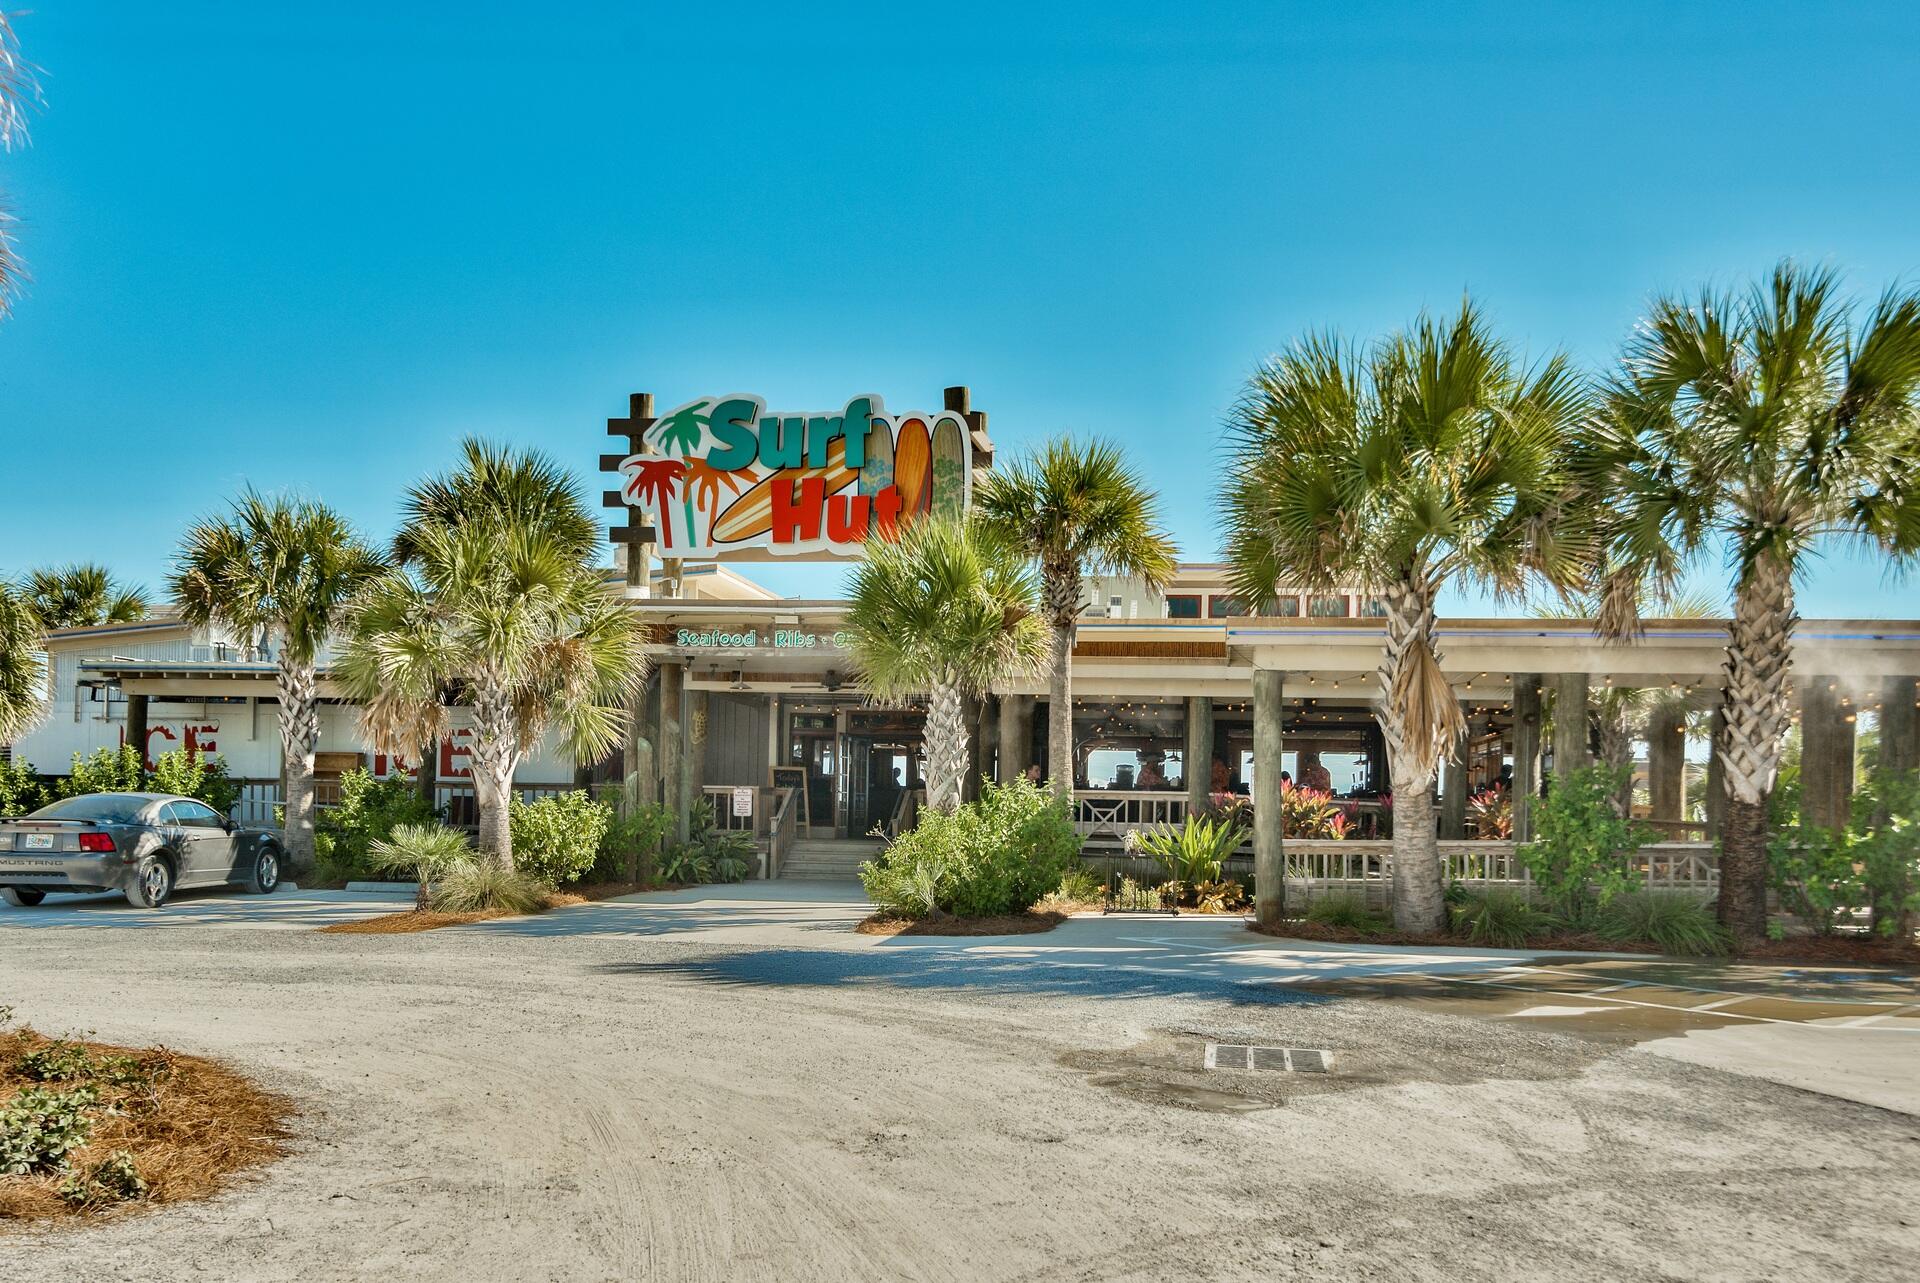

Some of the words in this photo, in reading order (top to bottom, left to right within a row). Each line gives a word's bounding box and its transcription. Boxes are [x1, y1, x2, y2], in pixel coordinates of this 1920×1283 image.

[706, 398, 873, 472] Surf
[771, 477, 903, 544] Hut
[677, 629, 756, 648] Seafood
[774, 630, 816, 648] Ribs
[120, 723, 220, 773] CE
